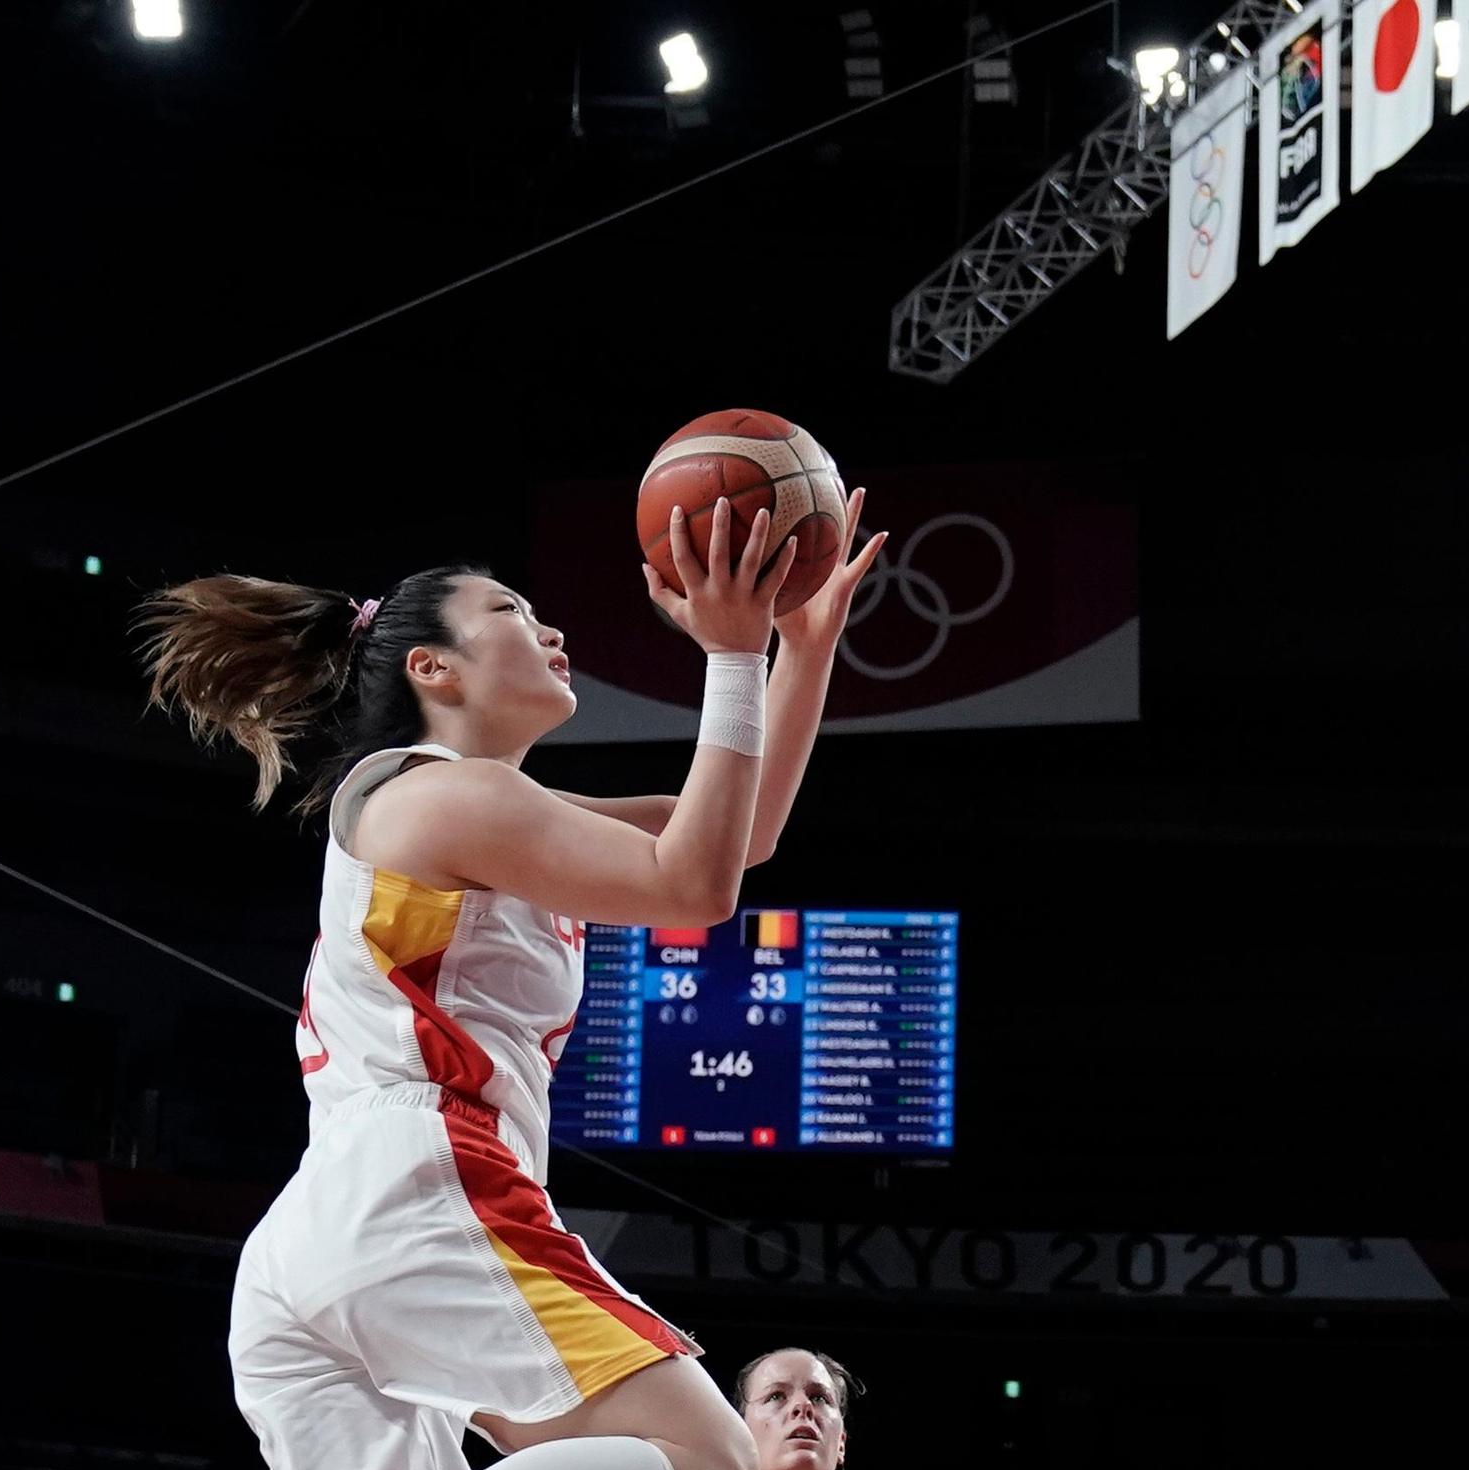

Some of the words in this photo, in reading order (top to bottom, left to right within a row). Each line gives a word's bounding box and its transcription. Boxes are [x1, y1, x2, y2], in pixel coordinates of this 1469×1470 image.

[660, 947, 698, 964] CHN
[752, 949, 784, 965] BEL
[659, 971, 698, 1000] 36
[748, 972, 787, 1001] 33
[689, 1051, 754, 1078] 1:46
[674, 1218, 1017, 1291] TOKYO
[1049, 1234, 1300, 1297] 2020
